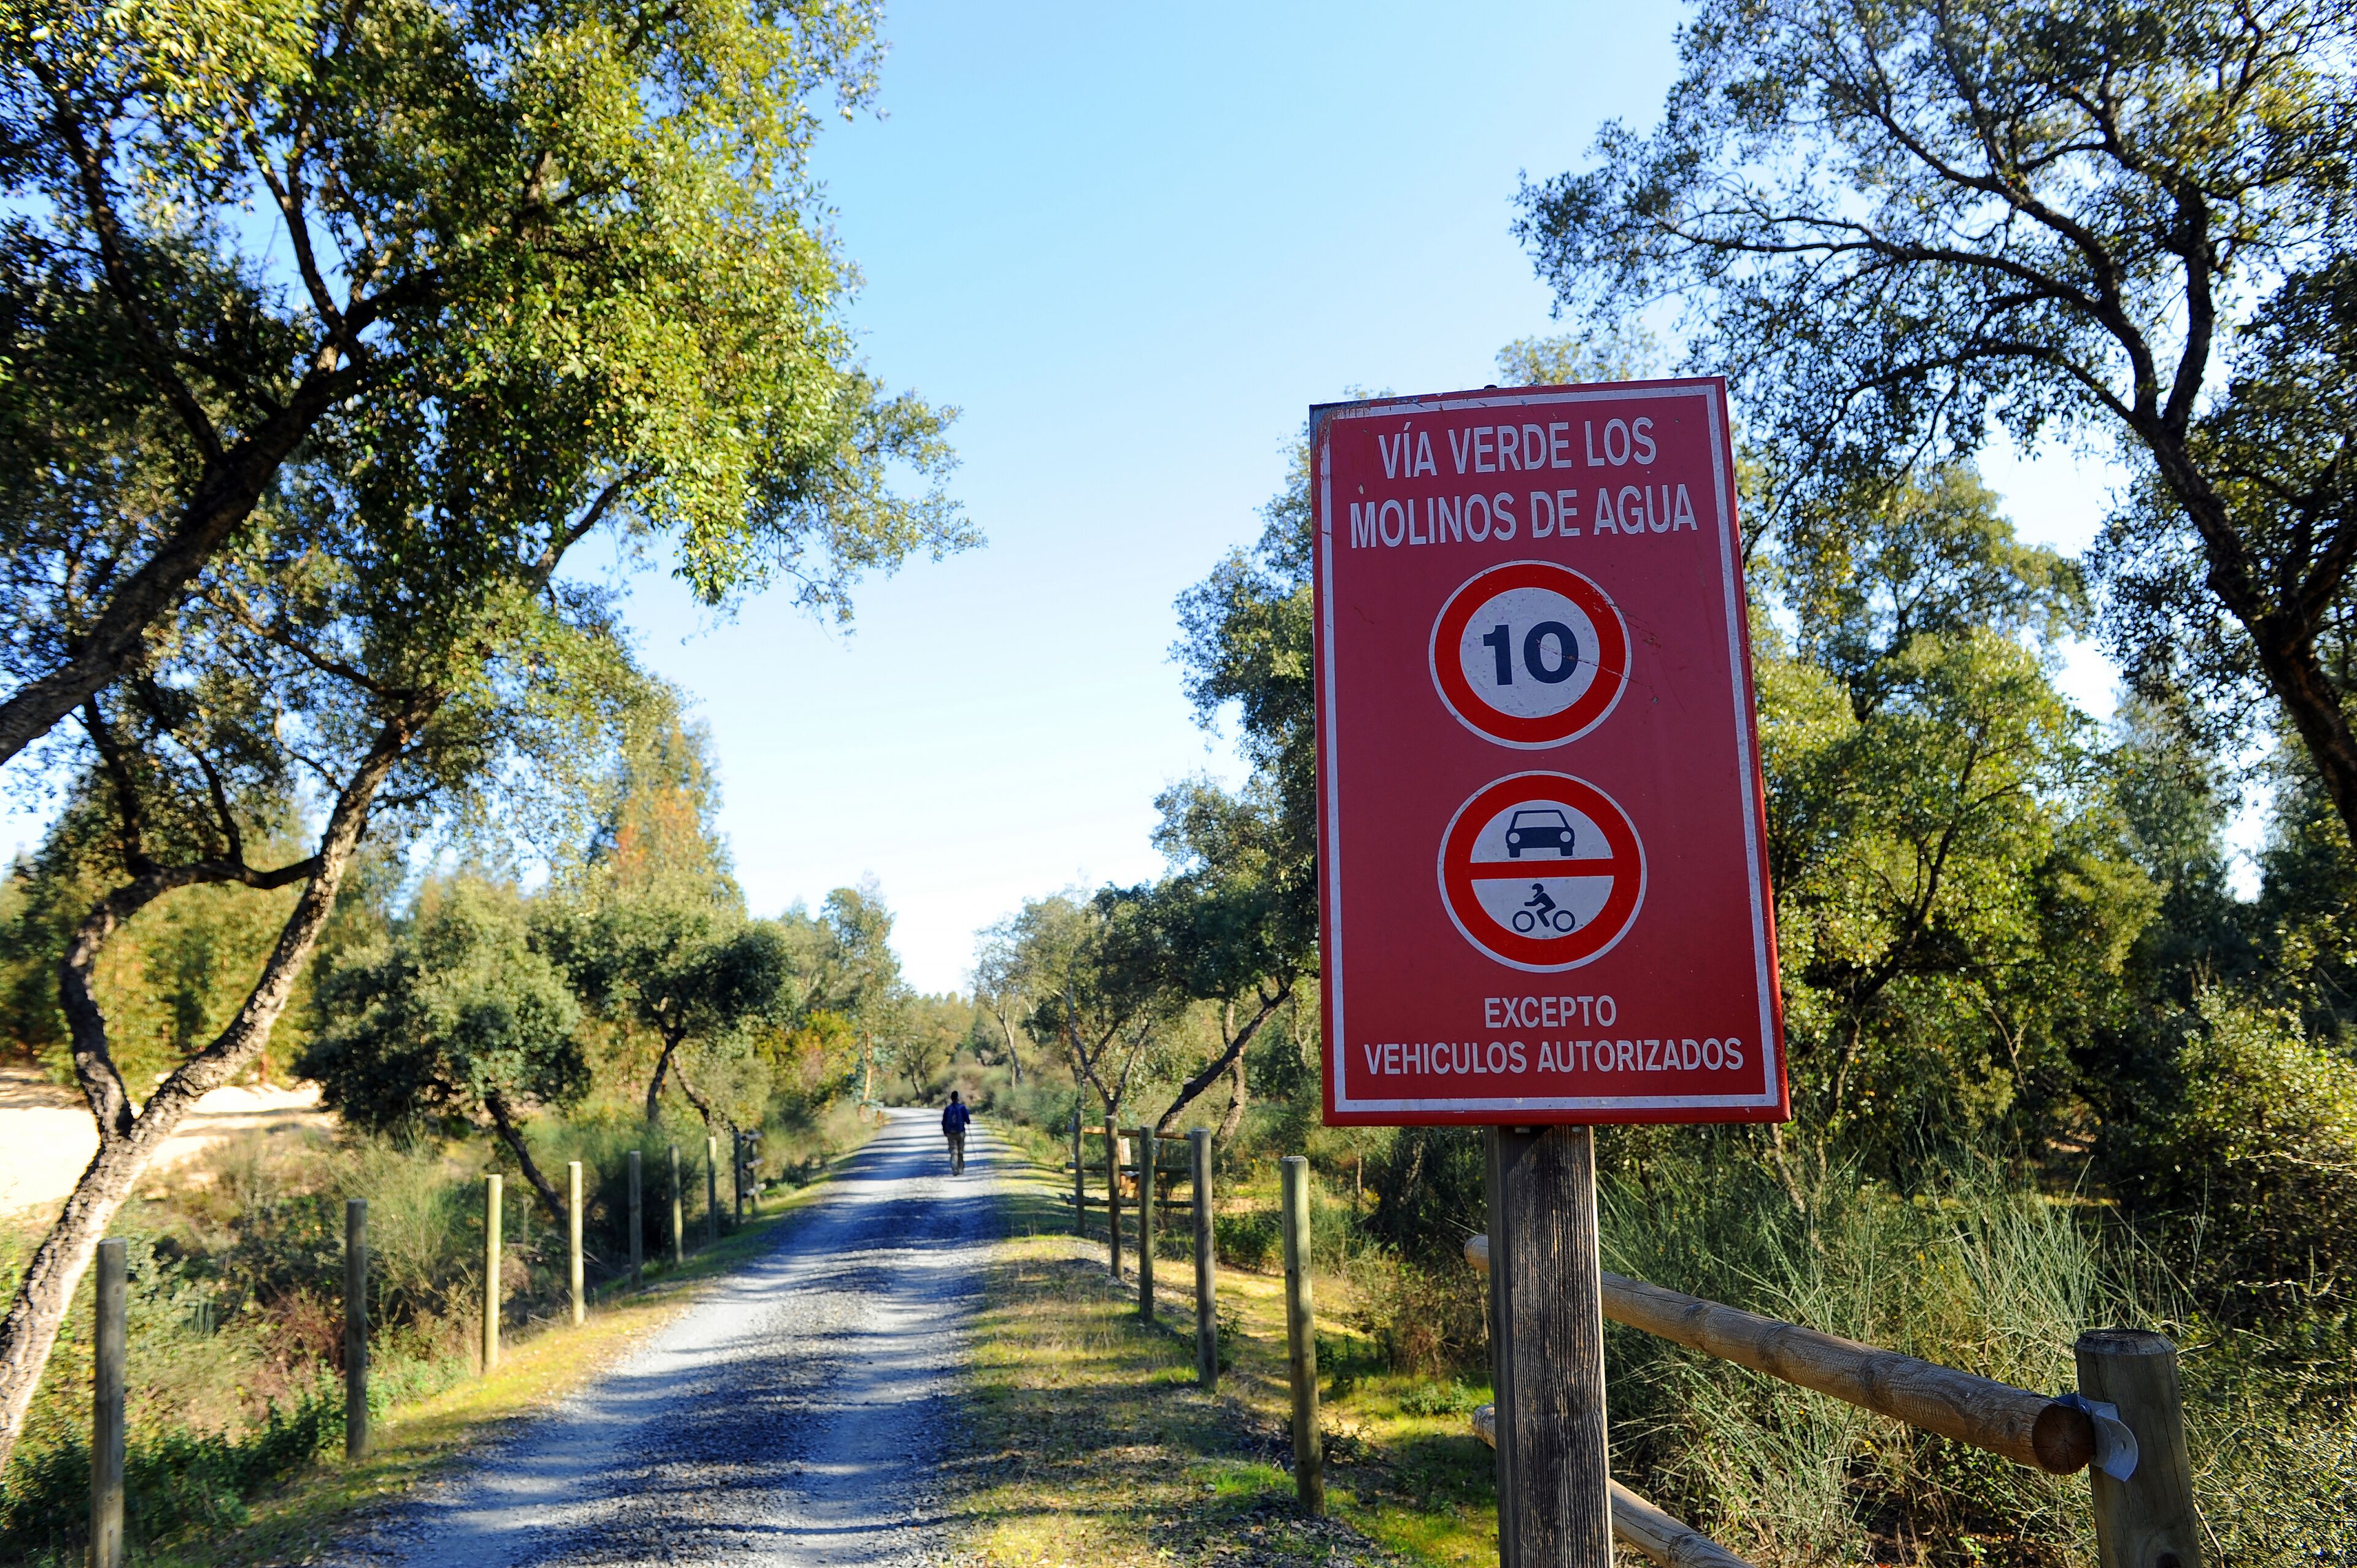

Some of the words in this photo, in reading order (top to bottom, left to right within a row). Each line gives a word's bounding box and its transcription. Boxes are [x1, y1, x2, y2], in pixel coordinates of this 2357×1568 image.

[1378, 422, 1438, 479] VÍA
[1447, 422, 1572, 474] VERDE
[1585, 417, 1657, 467] LOS
[1350, 492, 1517, 549] MOLINOS
[1530, 489, 1581, 538] DE
[1593, 484, 1698, 535] AGUA
[1482, 620, 1579, 686] 10
[1485, 995, 1617, 1029] EXCEPTO
[1364, 1041, 1527, 1075] VEHICULOS
[1537, 1037, 1744, 1072] AUTORIZADOS
